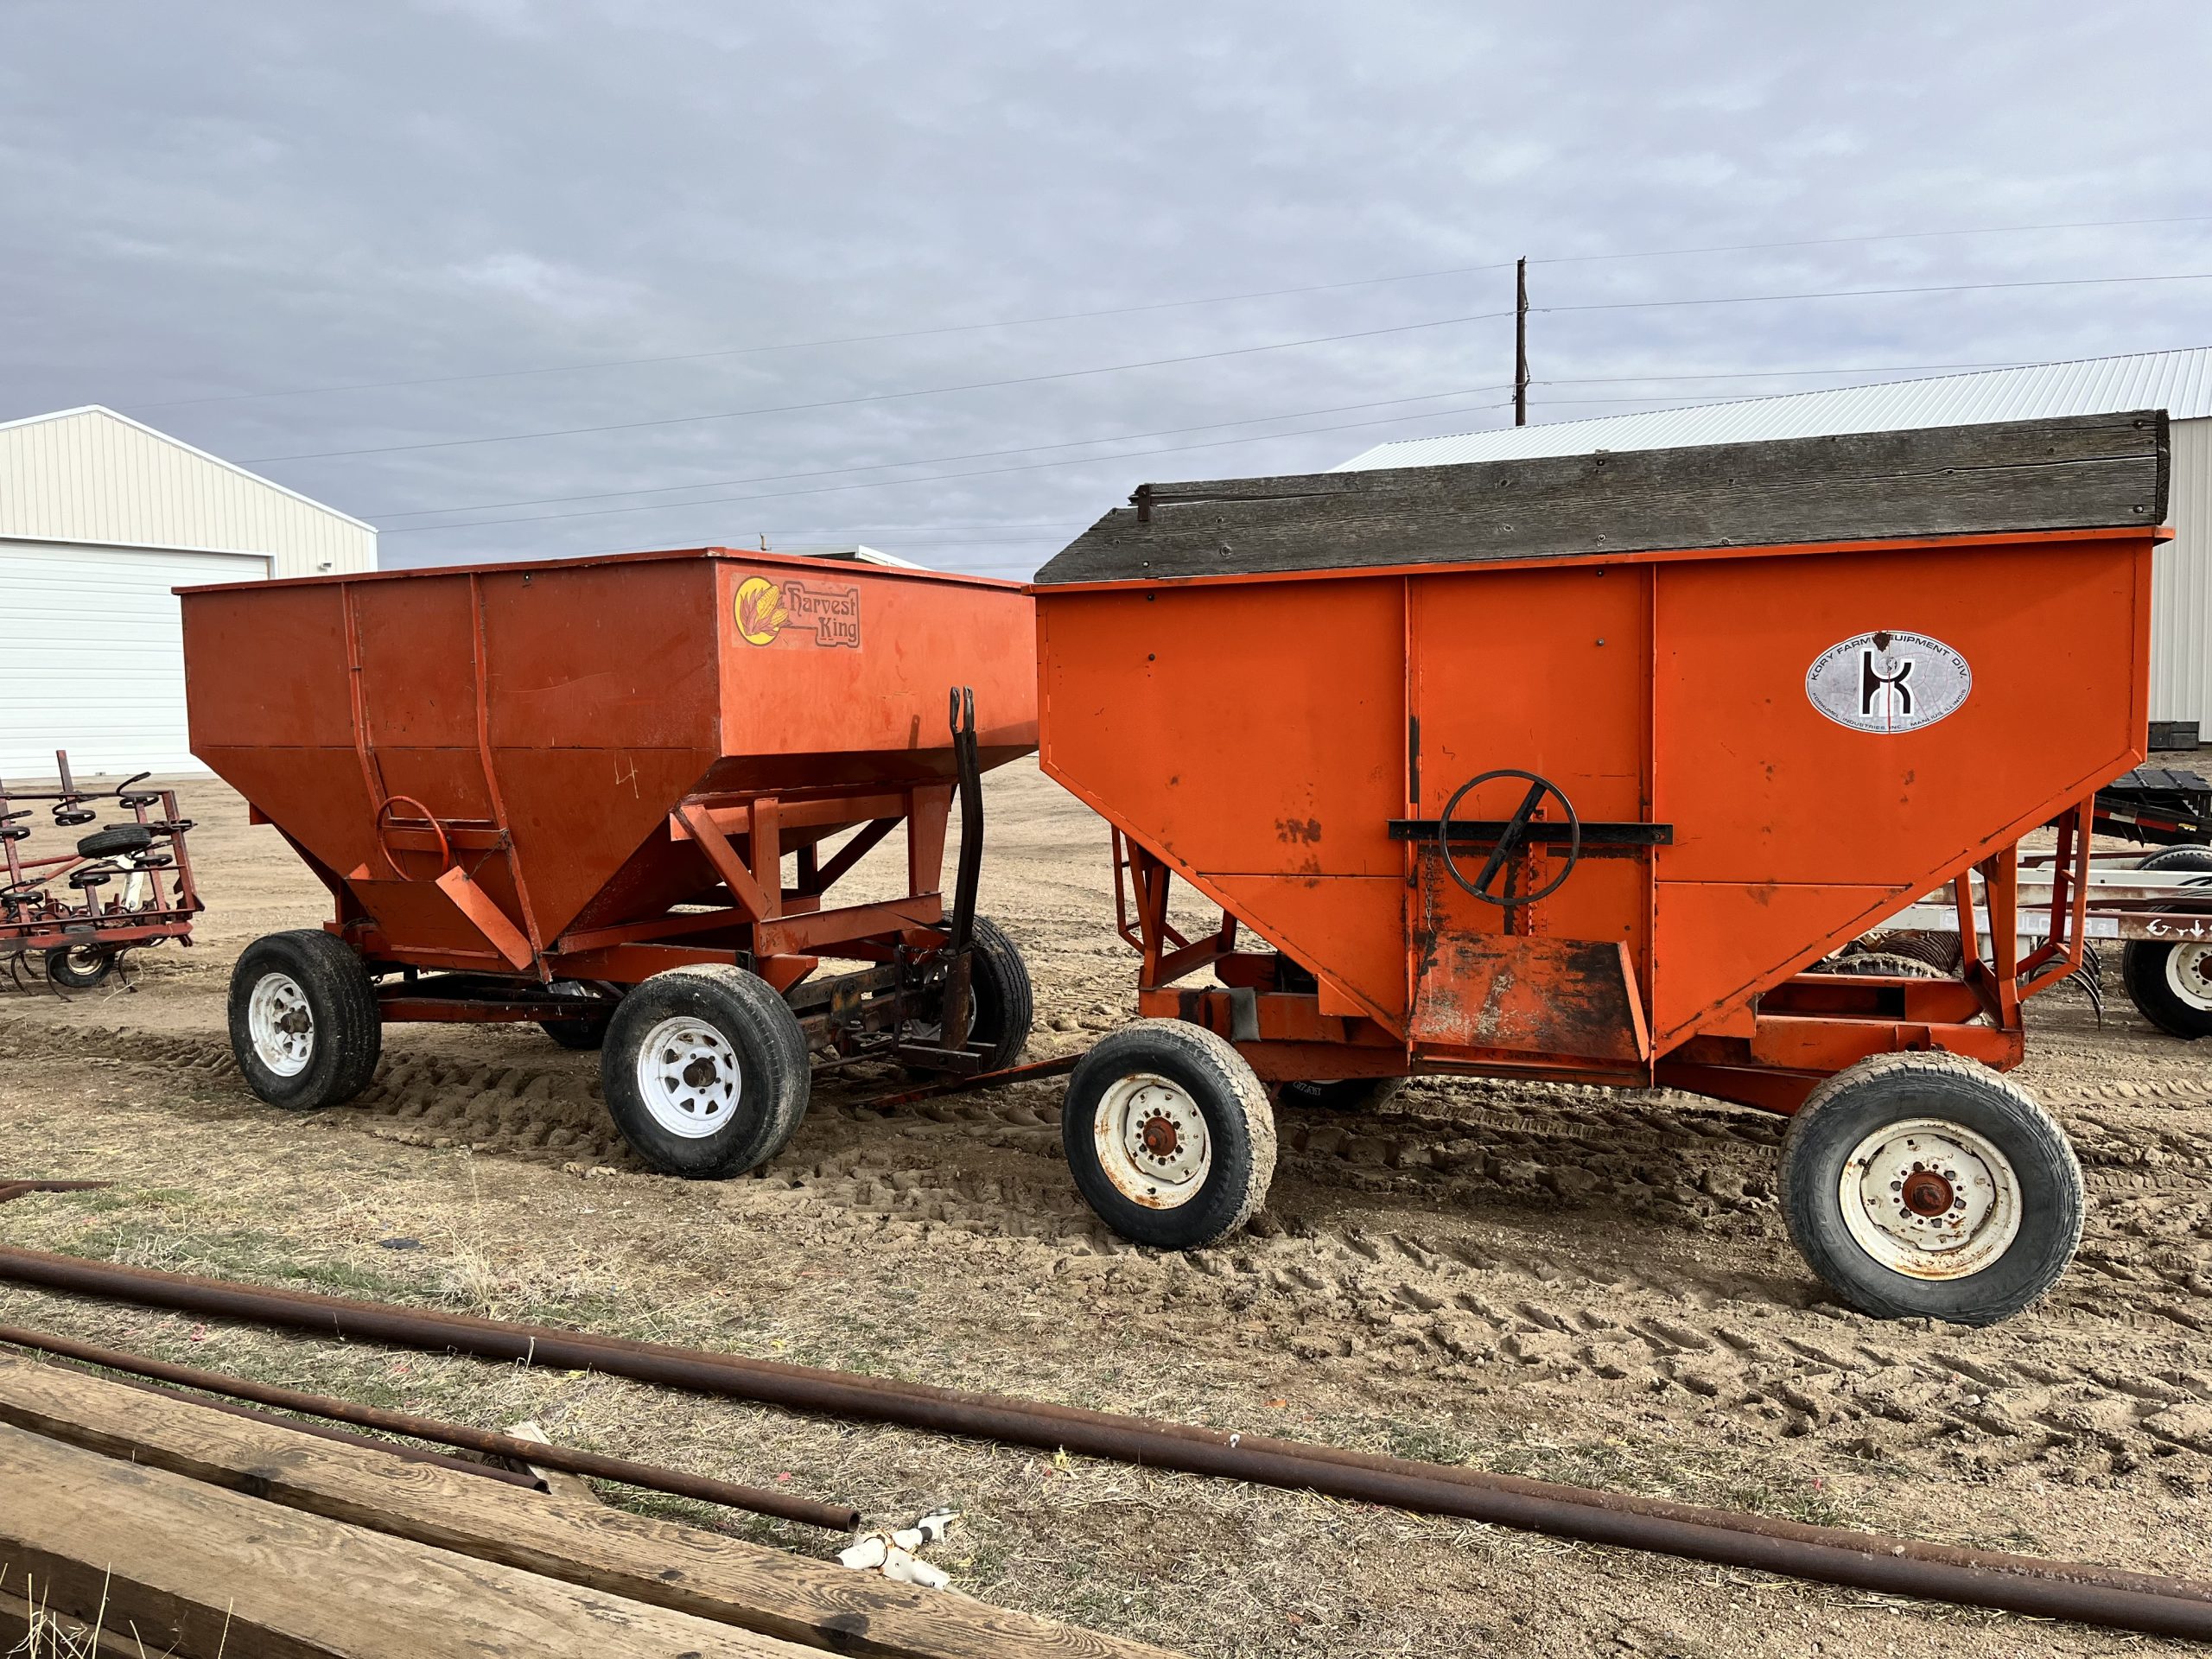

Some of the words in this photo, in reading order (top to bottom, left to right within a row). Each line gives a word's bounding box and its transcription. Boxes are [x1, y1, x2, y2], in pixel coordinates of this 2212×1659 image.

[818, 616, 857, 642] King
[1811, 652, 1834, 681] KORY
[1836, 637, 1872, 655] FARM
[1889, 634, 1950, 657] UIPMENT
[1951, 658, 1967, 679] DIV.
